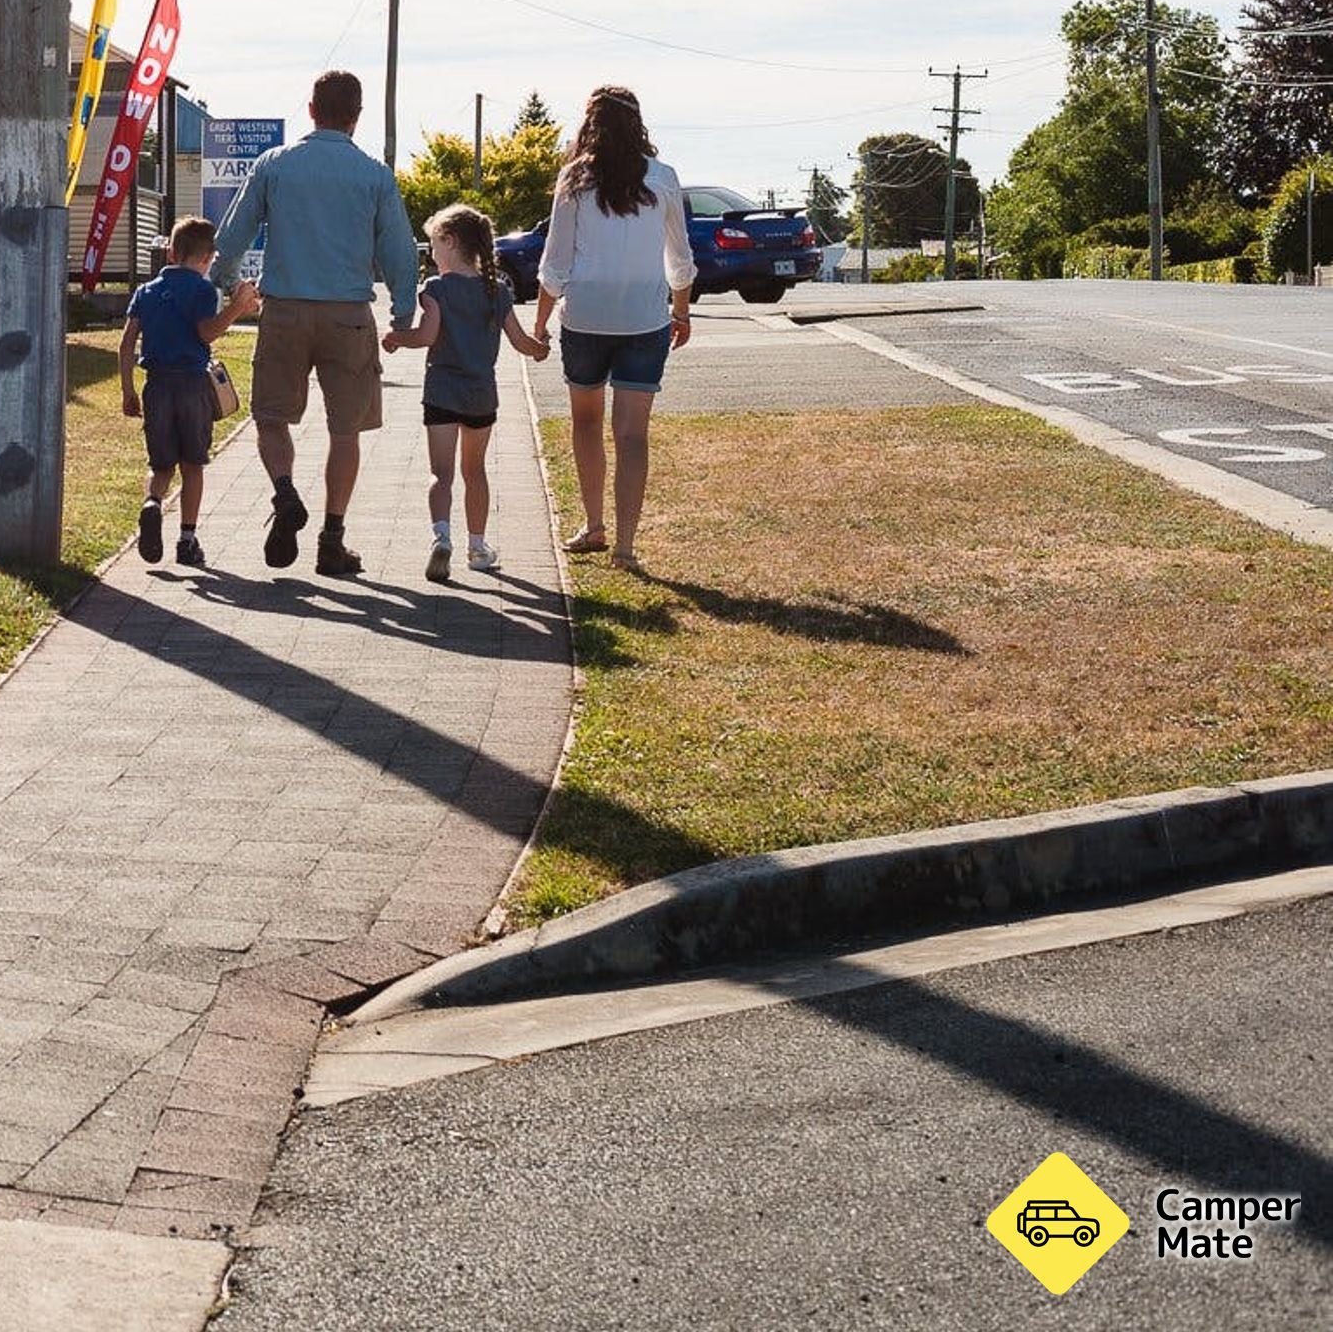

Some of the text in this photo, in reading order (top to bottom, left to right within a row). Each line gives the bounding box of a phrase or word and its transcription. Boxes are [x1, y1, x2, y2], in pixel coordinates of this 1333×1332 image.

[126, 22, 176, 120] NOW
[209, 122, 279, 132] GREAT WESTERN
[238, 134, 272, 143] VISITOR
[227, 145, 259, 155] CENTRE
[1021, 365, 1333, 394] BUS
